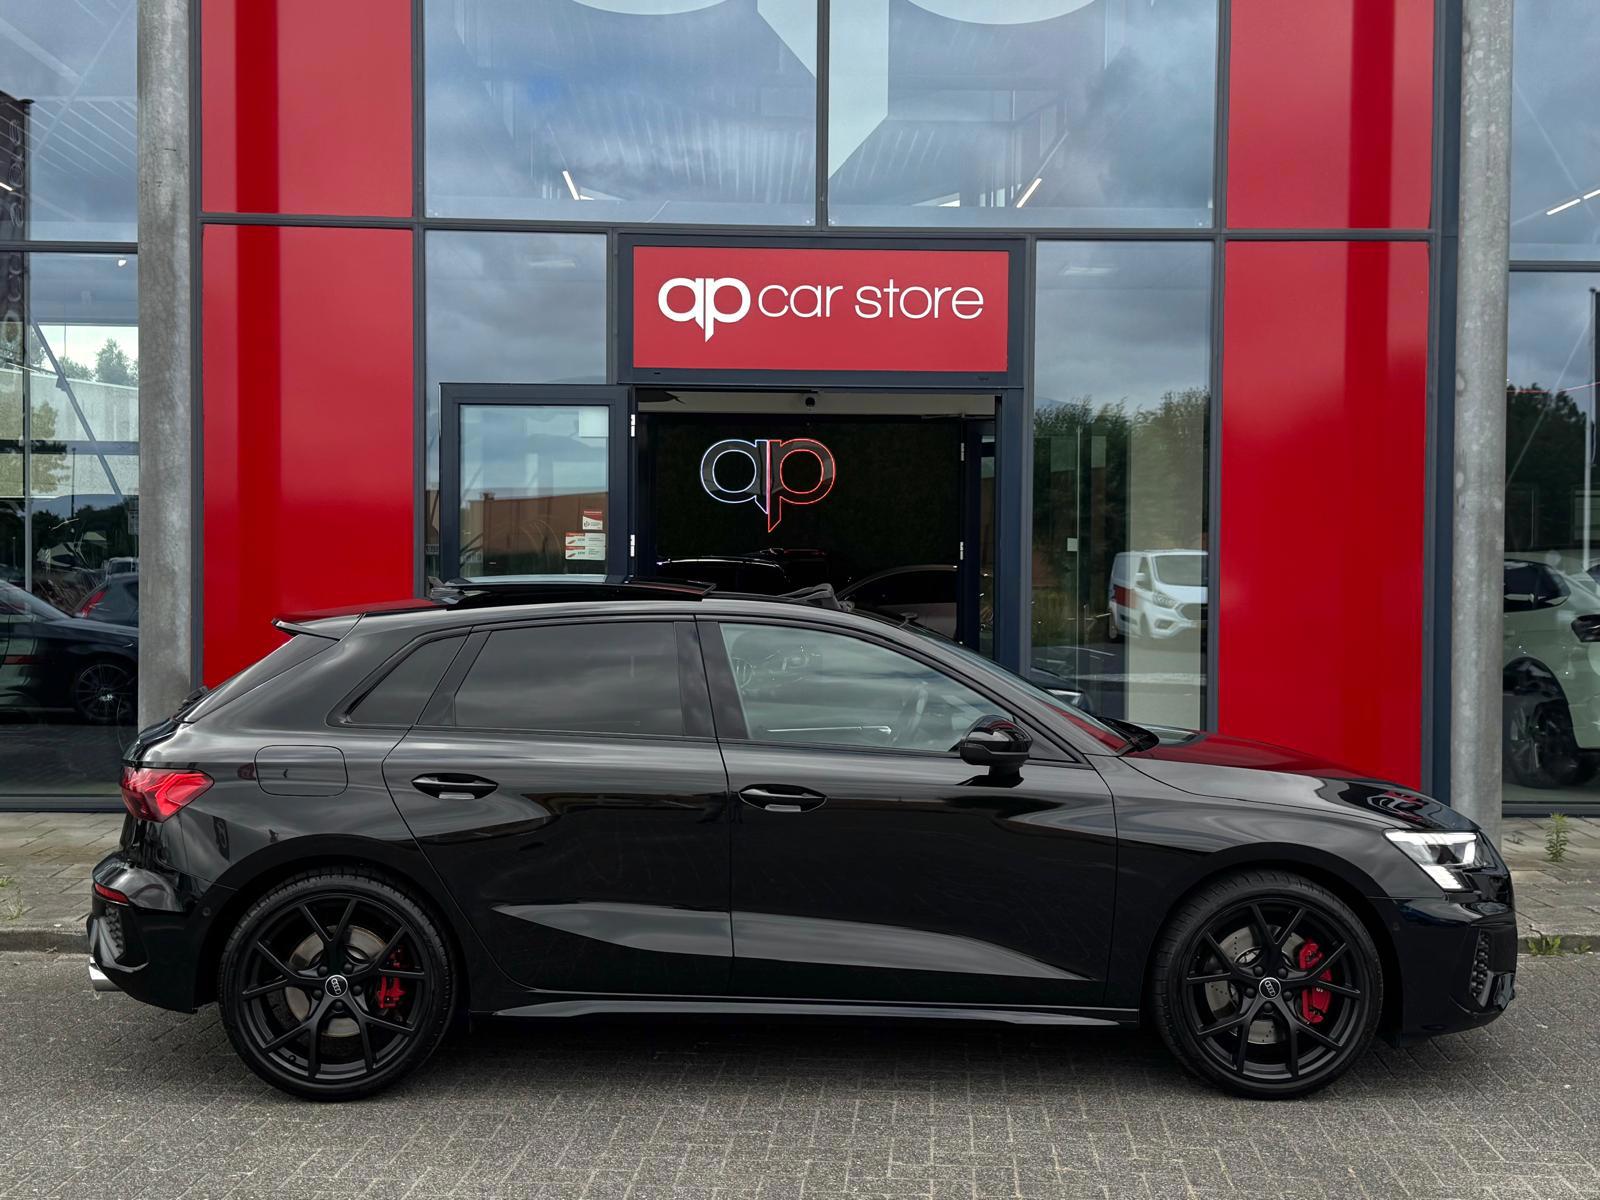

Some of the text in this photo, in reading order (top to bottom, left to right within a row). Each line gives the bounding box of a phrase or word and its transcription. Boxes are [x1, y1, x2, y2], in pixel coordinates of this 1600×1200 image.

[658, 278, 983, 342] ap car store
